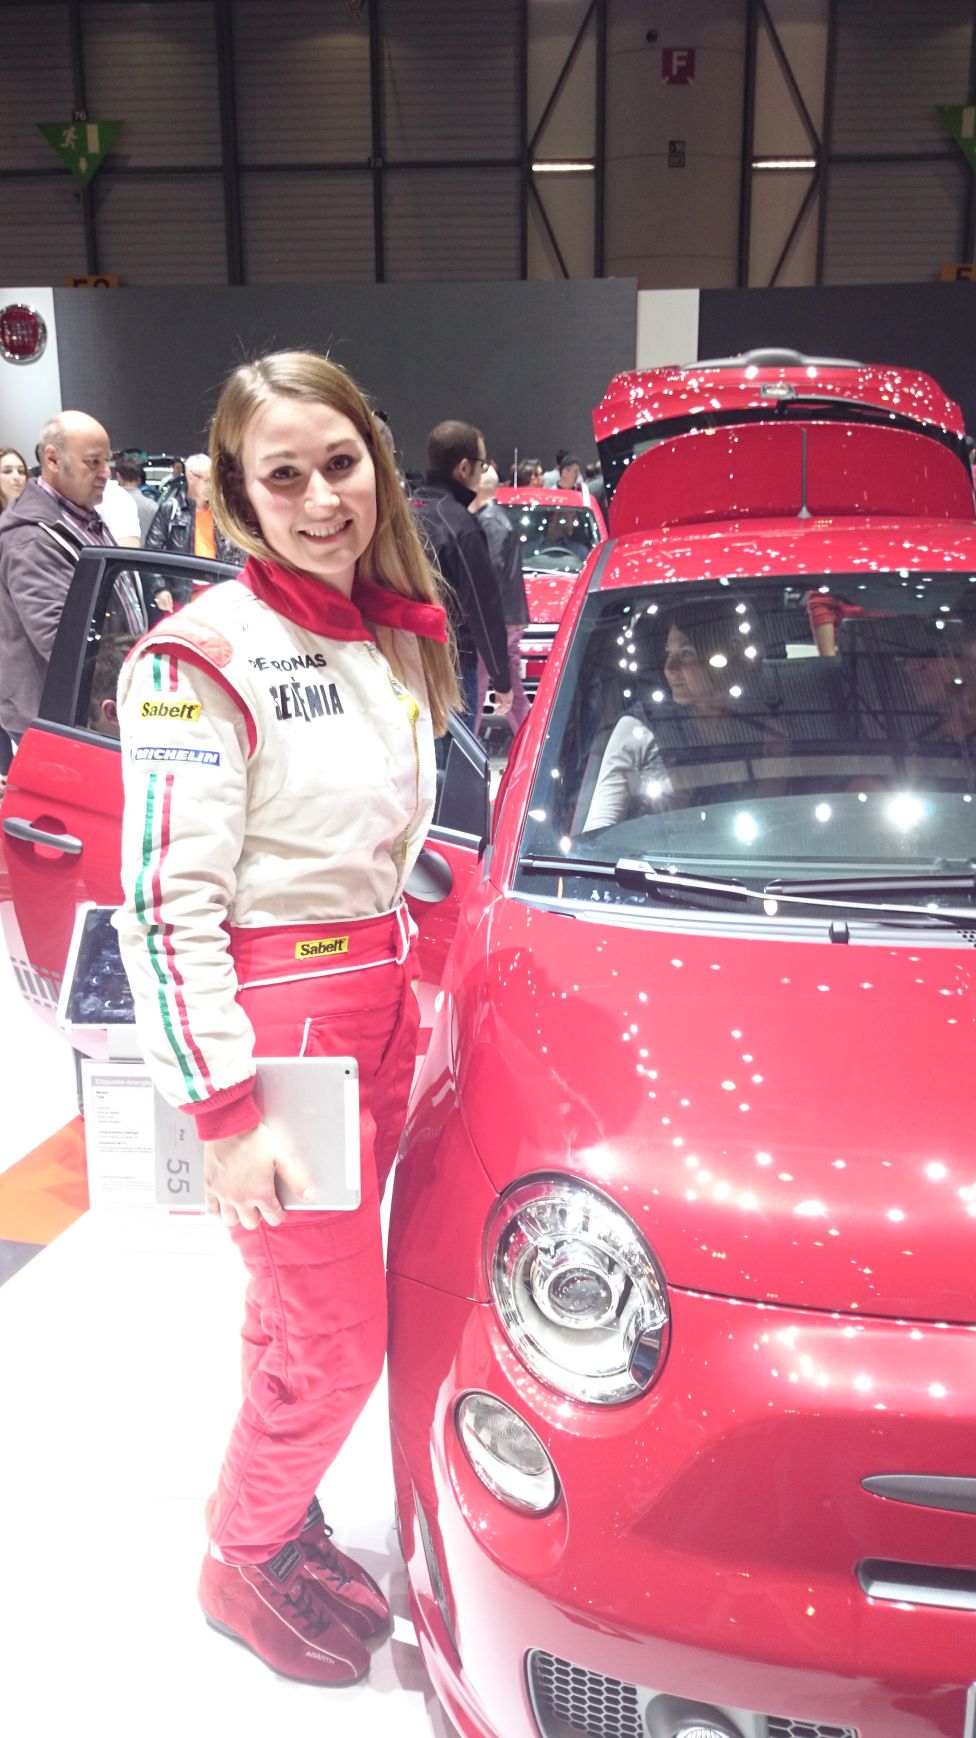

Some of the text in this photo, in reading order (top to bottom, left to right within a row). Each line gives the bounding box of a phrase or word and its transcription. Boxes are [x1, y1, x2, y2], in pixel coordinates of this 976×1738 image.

[672, 50, 689, 76] F
[248, 653, 327, 672] PERONAS
[141, 701, 198, 719] Sabelt
[136, 748, 219, 764] MICHELIN
[300, 938, 345, 956] Sabelt
[167, 1158, 190, 1194] 55
